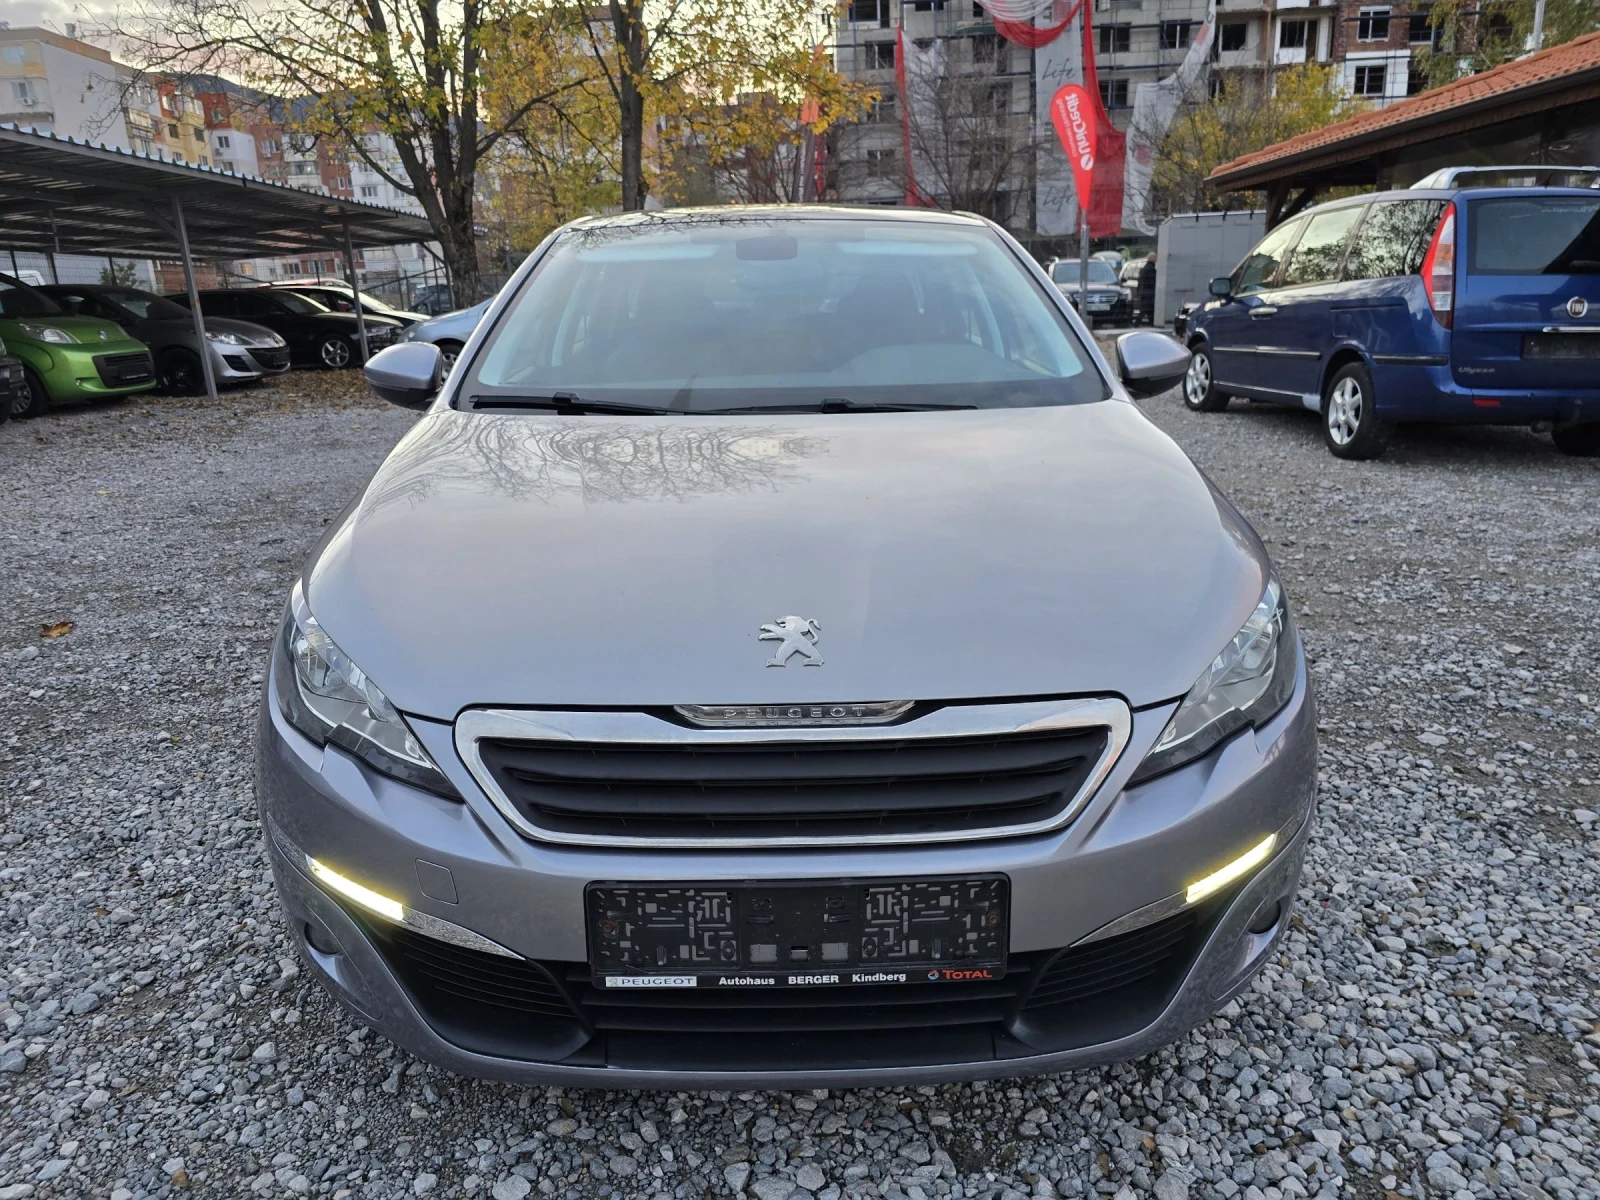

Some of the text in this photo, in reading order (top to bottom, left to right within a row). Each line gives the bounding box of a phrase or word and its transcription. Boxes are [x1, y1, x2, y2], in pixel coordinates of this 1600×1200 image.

[723, 706, 867, 719] PEUGEOT
[718, 973, 907, 985] Autohaus BERGER Kindberg
[942, 969, 993, 979] TOTAL
[621, 977, 694, 986] PEUGEOT
